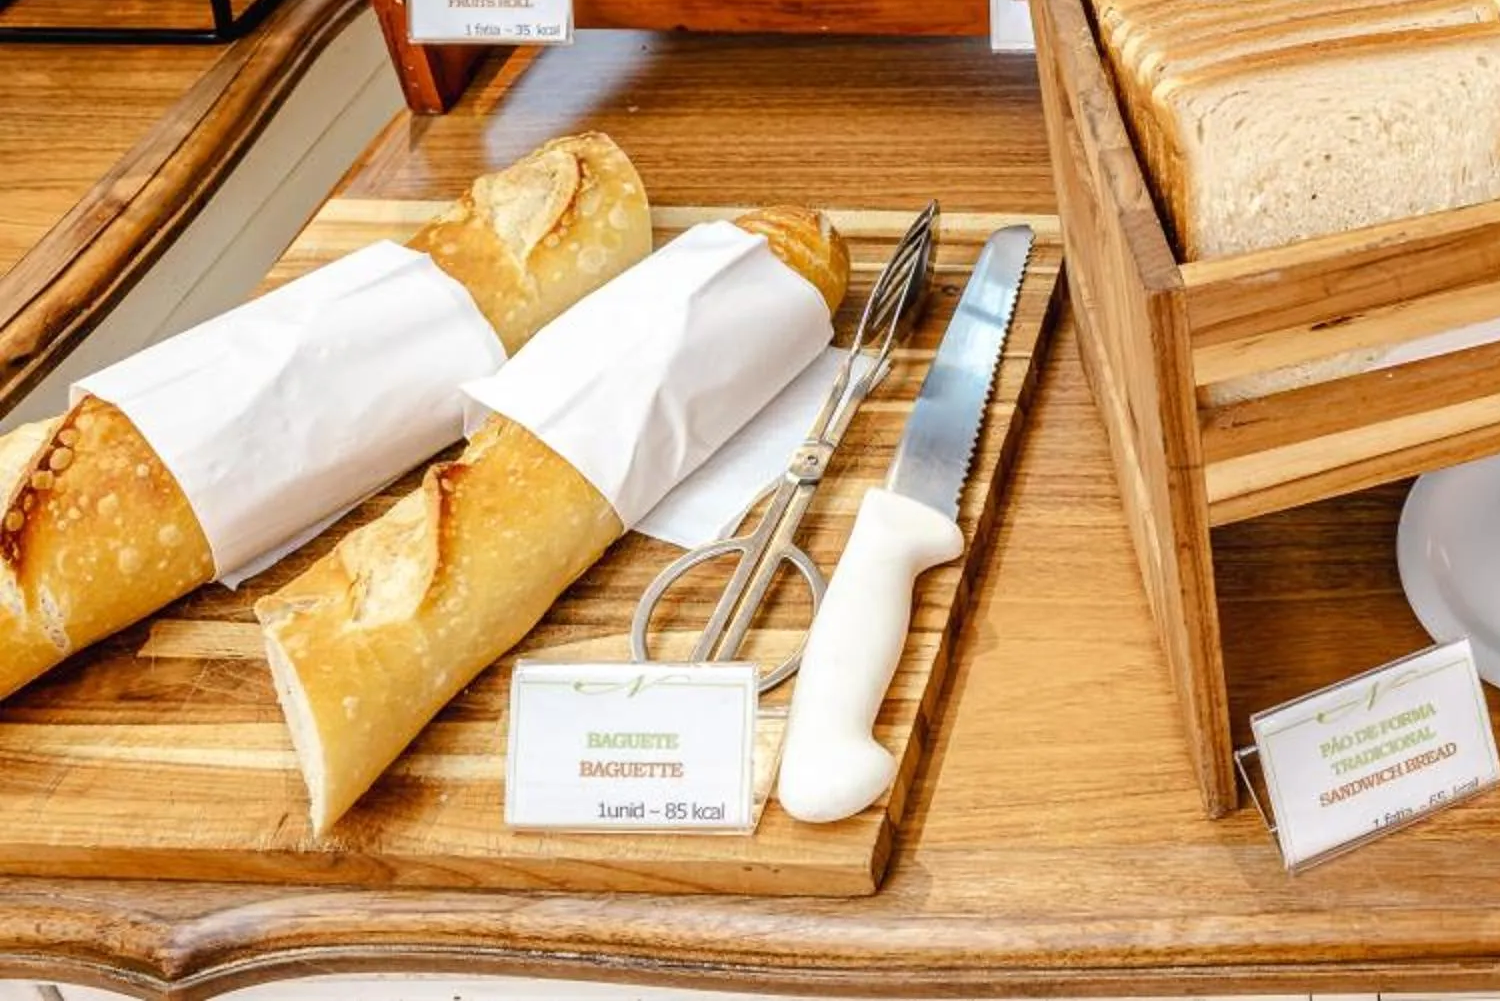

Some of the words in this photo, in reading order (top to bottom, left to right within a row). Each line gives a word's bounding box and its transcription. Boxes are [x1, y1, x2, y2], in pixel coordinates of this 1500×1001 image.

[587, 732, 679, 750] BAGUETE
[1318, 734, 1354, 759] PÃO
[1357, 725, 1379, 744] DE
[1380, 702, 1437, 734] FORMA
[1330, 726, 1437, 776] TRADICIONAL
[579, 761, 684, 778] BAGUETTE
[1319, 765, 1405, 808] SANDWICH
[1405, 741, 1457, 776] BREAD
[598, 801, 645, 819] 1unid
[665, 802, 687, 820] 85
[692, 802, 725, 821] kcal
